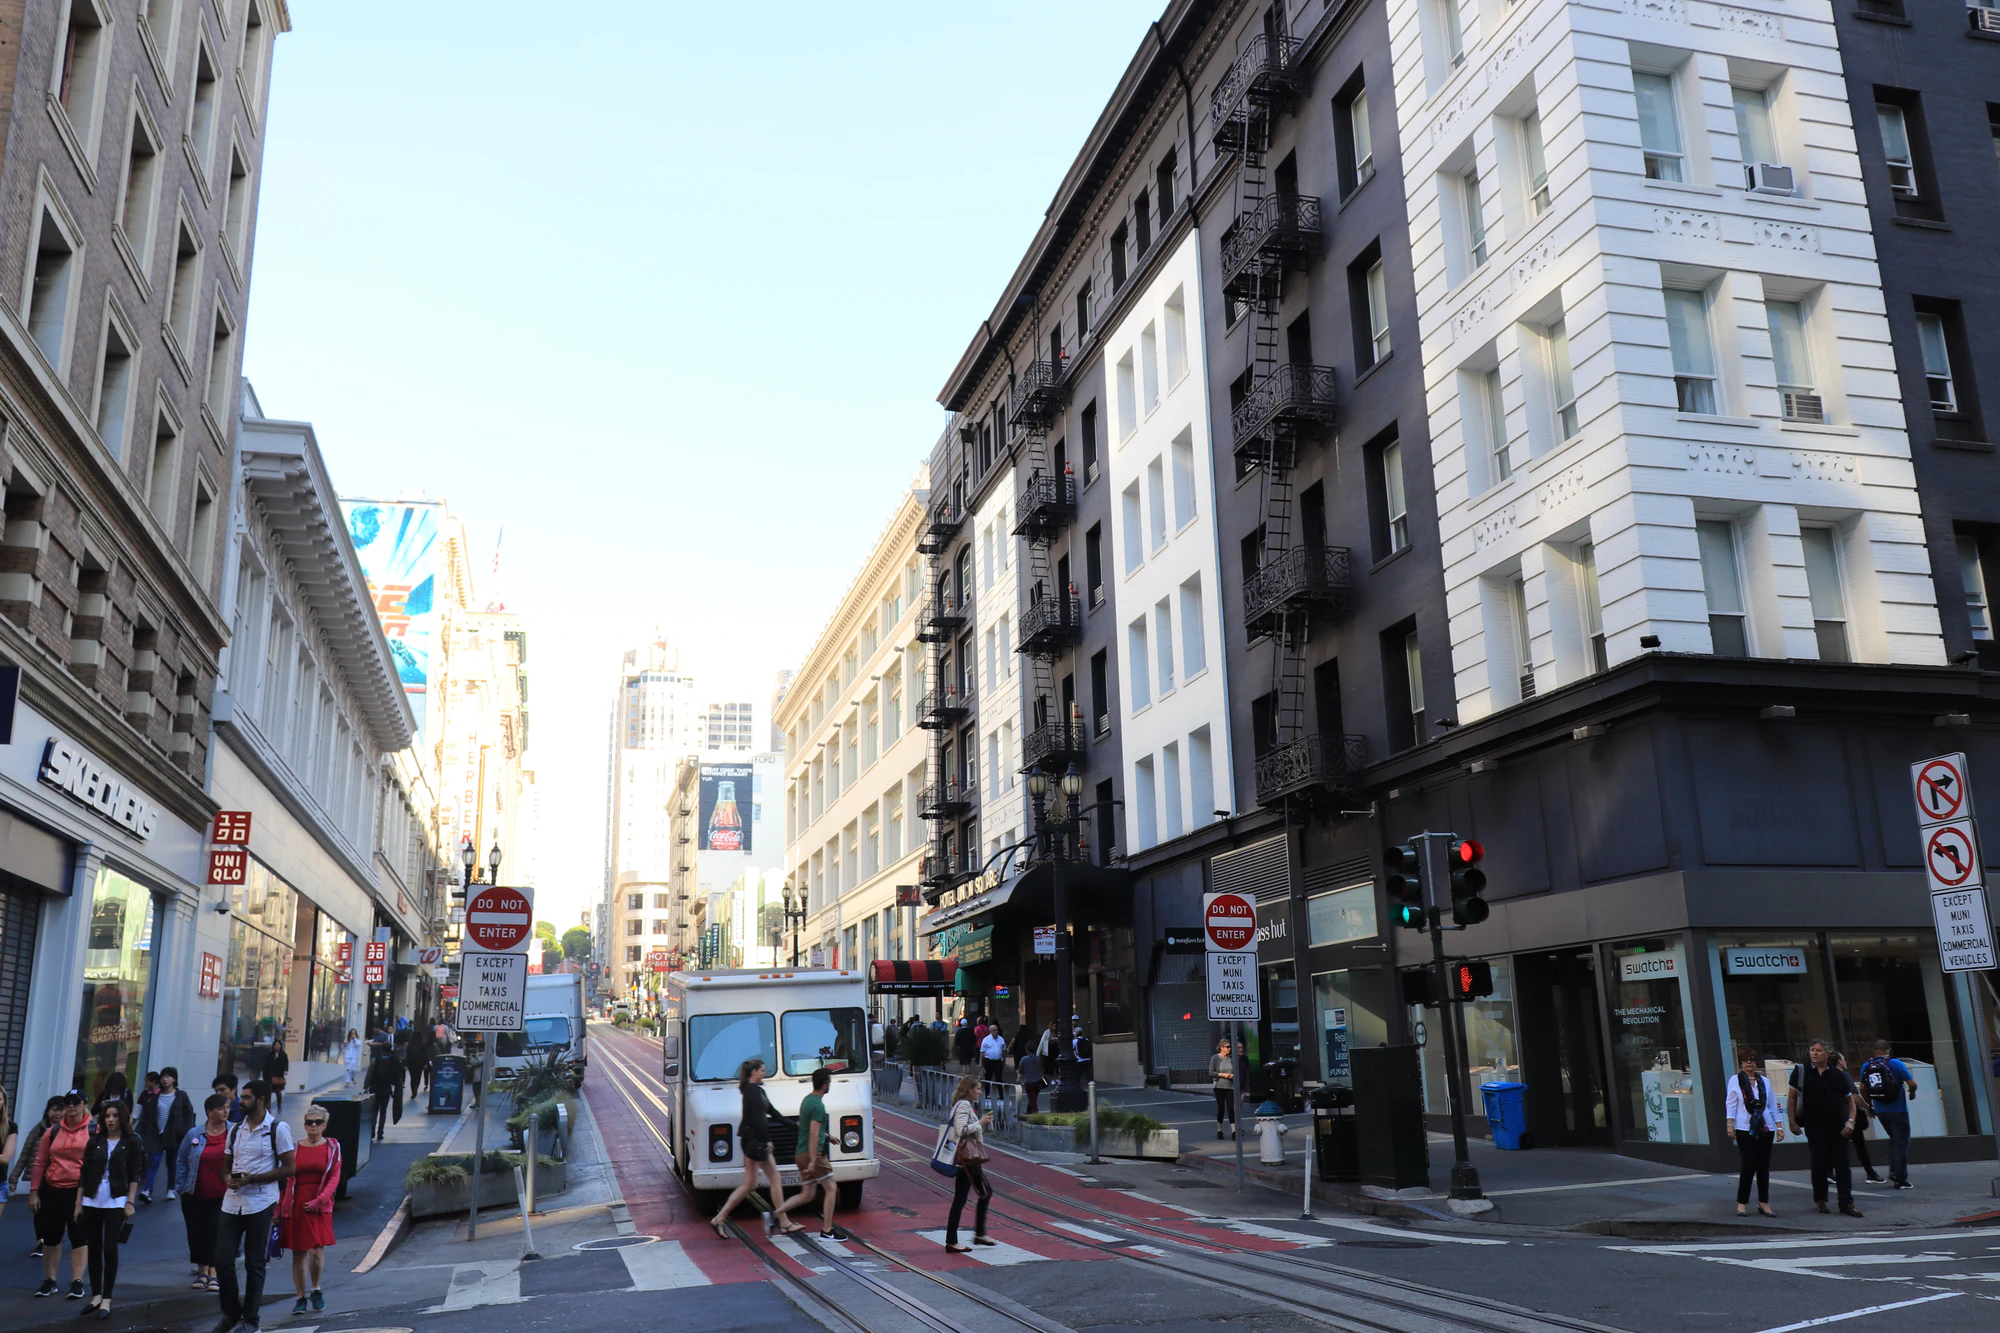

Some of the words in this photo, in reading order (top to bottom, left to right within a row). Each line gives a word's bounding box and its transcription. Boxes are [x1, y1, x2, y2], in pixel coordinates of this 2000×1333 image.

[43, 737, 159, 841] SKECHERS
[461, 732, 477, 851] HERBER
[214, 855, 240, 867] UNI
[212, 868, 242, 882] QLO
[477, 898, 494, 909] DO
[500, 900, 524, 910] NOT
[940, 889, 956, 911] HOTEL
[1942, 894, 1972, 908] EXCEPT
[1212, 905, 1225, 914] DO
[1230, 906, 1248, 914] NOT
[1950, 909, 1970, 921] MUNI
[479, 928, 516, 938] ENTER
[1270, 918, 1287, 939] hut
[1951, 924, 1974, 936] TAXIS
[1216, 930, 1246, 939] ENTER
[1942, 937, 1989, 952] COMMERCIAL
[476, 957, 514, 968] EXCEPT
[1218, 956, 1247, 965] EXCEPT
[1734, 954, 1790, 968] swatch
[1949, 953, 1988, 966] VEHICLES
[1223, 968, 1242, 977] MUNI
[1626, 959, 1666, 975] swatch
[366, 974, 382, 982] QLO
[482, 972, 506, 982] MUNI
[479, 986, 507, 996] TAXIS
[1222, 981, 1244, 990] TAXIS
[1211, 994, 1256, 1003] COMMERCIAL
[462, 1001, 520, 1012] COMMERCIAL
[1216, 1006, 1253, 1015] VEHICLES
[1626, 1006, 1666, 1015] MECHANICAL
[466, 1016, 514, 1026] VEHICLES
[1622, 1016, 1660, 1025] REVOLUTION
[1335, 1050, 1348, 1060] Lease
